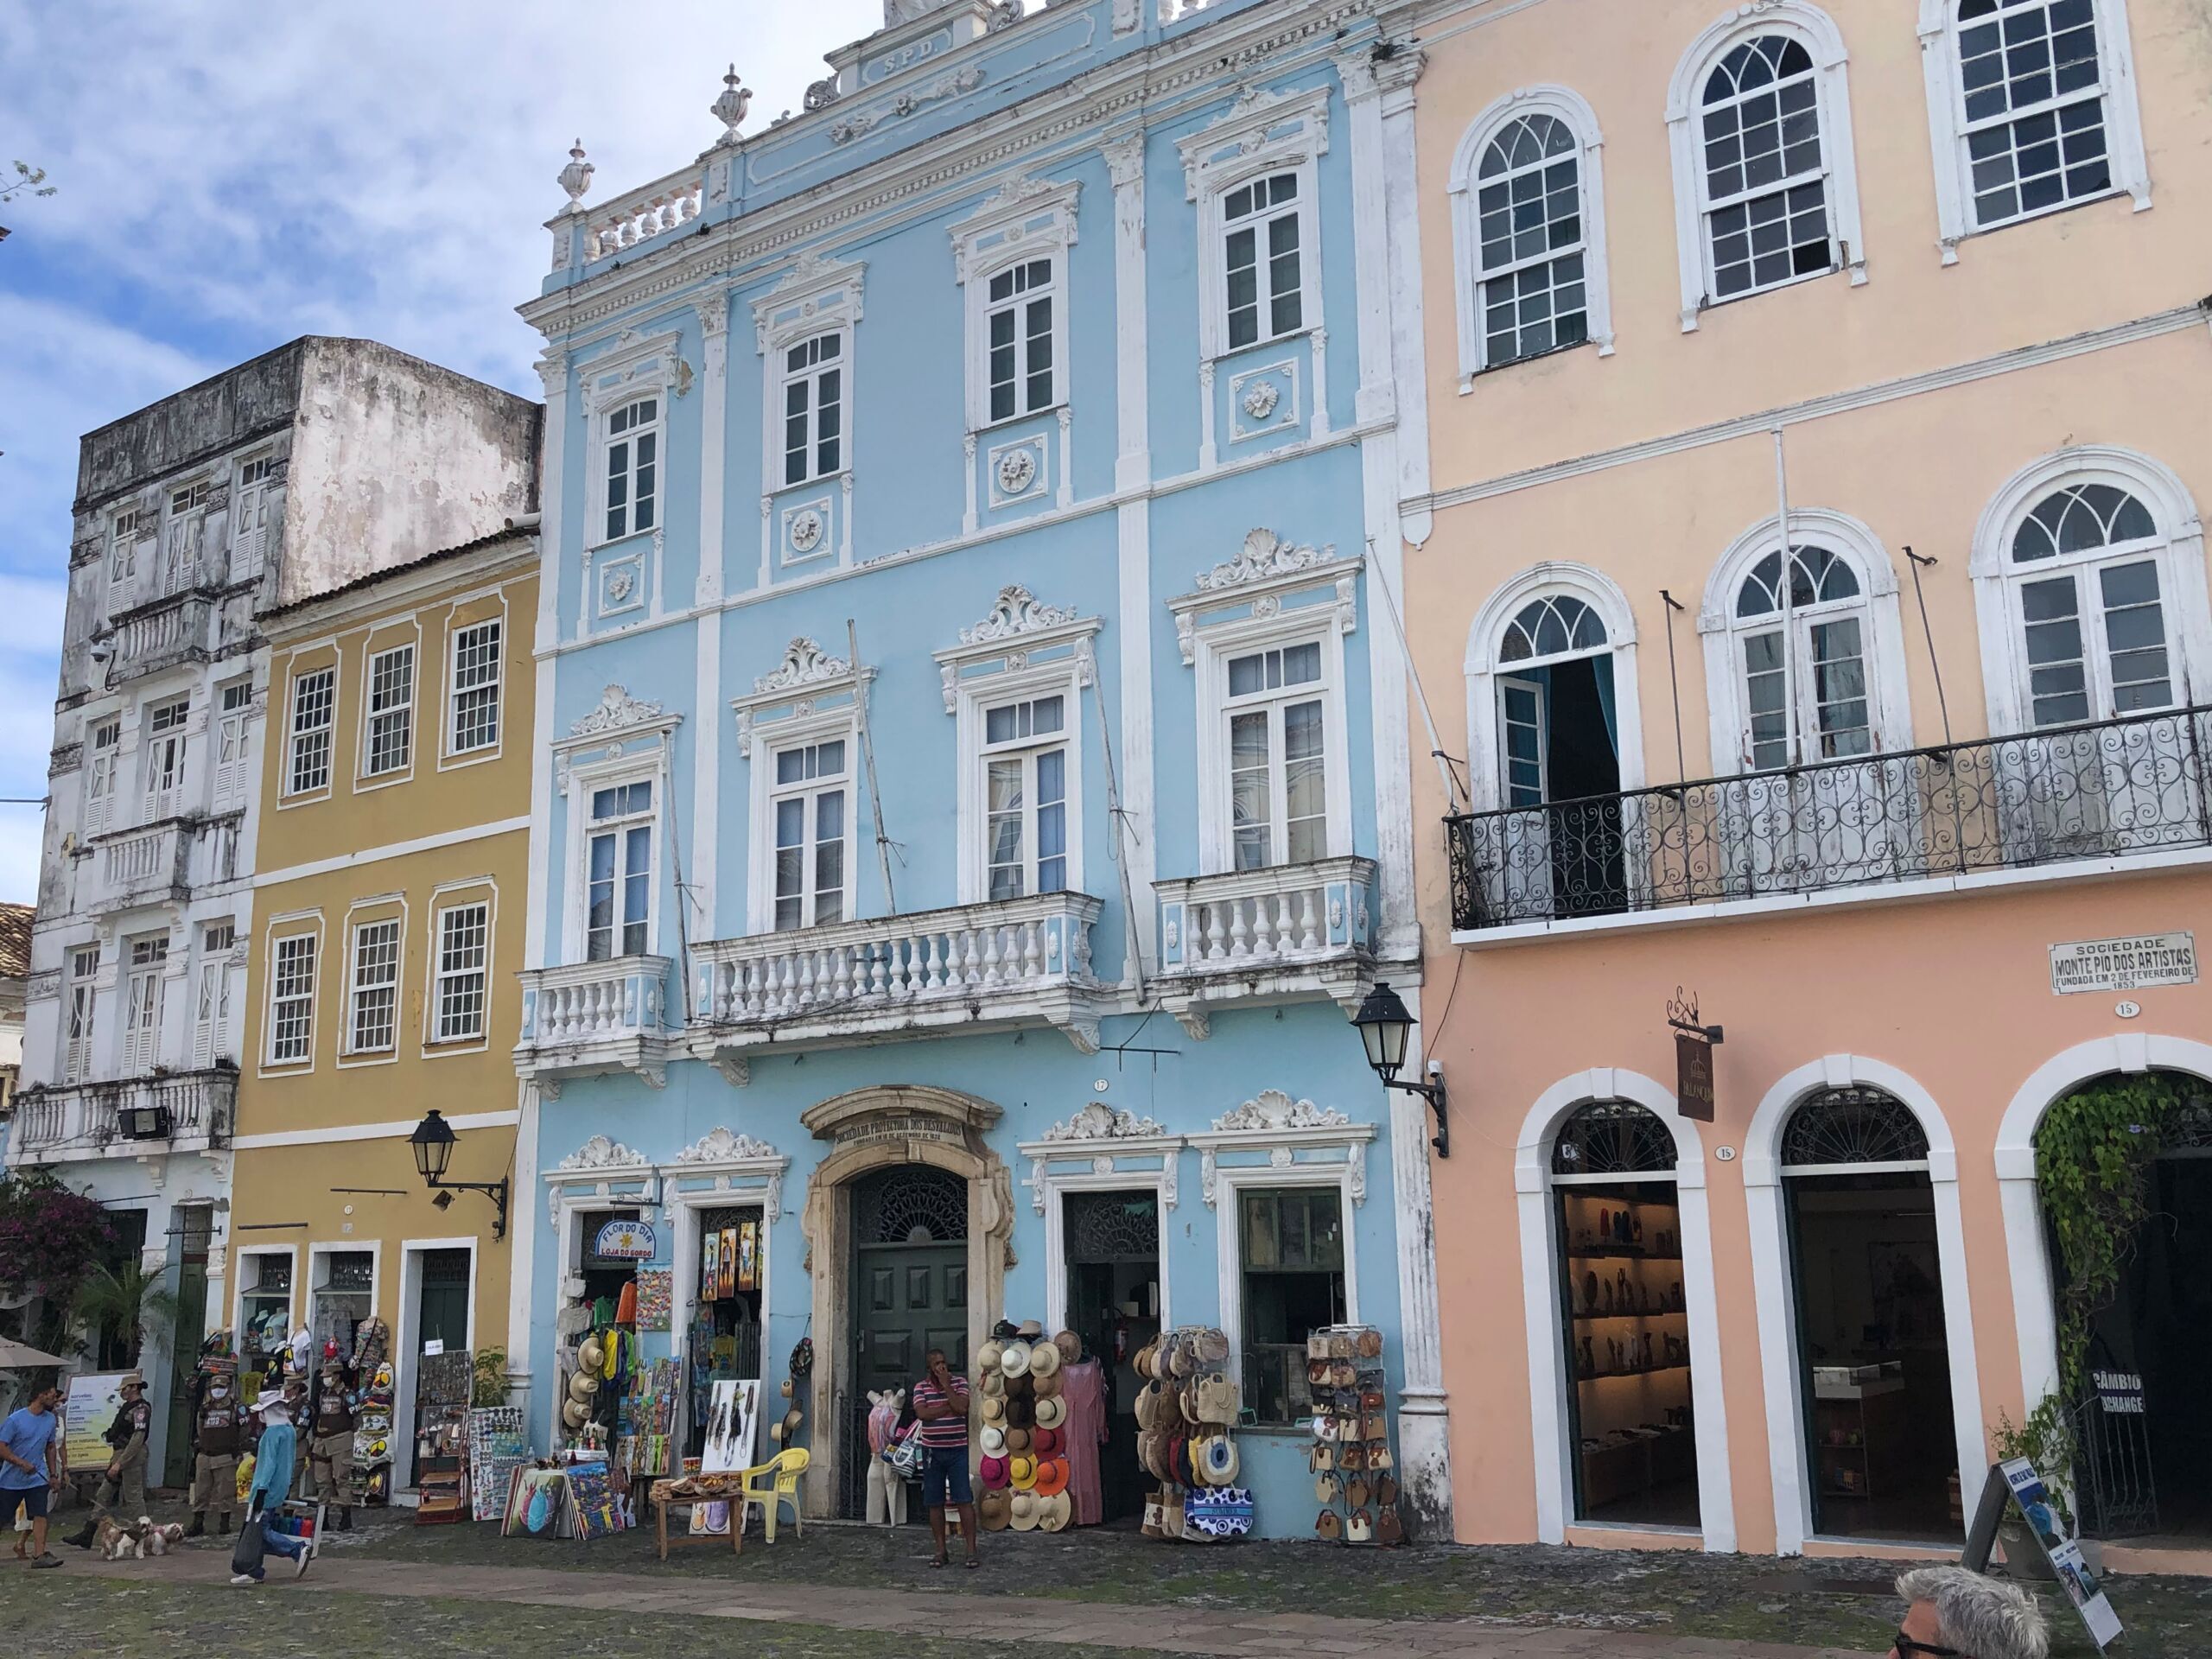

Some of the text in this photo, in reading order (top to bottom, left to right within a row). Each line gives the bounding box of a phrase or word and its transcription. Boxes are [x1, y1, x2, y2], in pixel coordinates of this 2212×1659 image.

[2076, 938, 2165, 955] SOCIEDADE
[2055, 948, 2192, 976] MONTE PIO DOS ARTISTAS
[2056, 966, 2194, 987] FUNDADA EM 2 DE FEVEREIRO DE
[2113, 981, 2135, 990] 1853
[2120, 1004, 2133, 1014] 15
[1097, 1081, 1105, 1090] 17
[910, 1118, 923, 1131] DOS
[1721, 1148, 1731, 1159] 15
[603, 1224, 652, 1243] FLOR DO DIA
[2093, 1370, 2141, 1390] CÂMBIO
